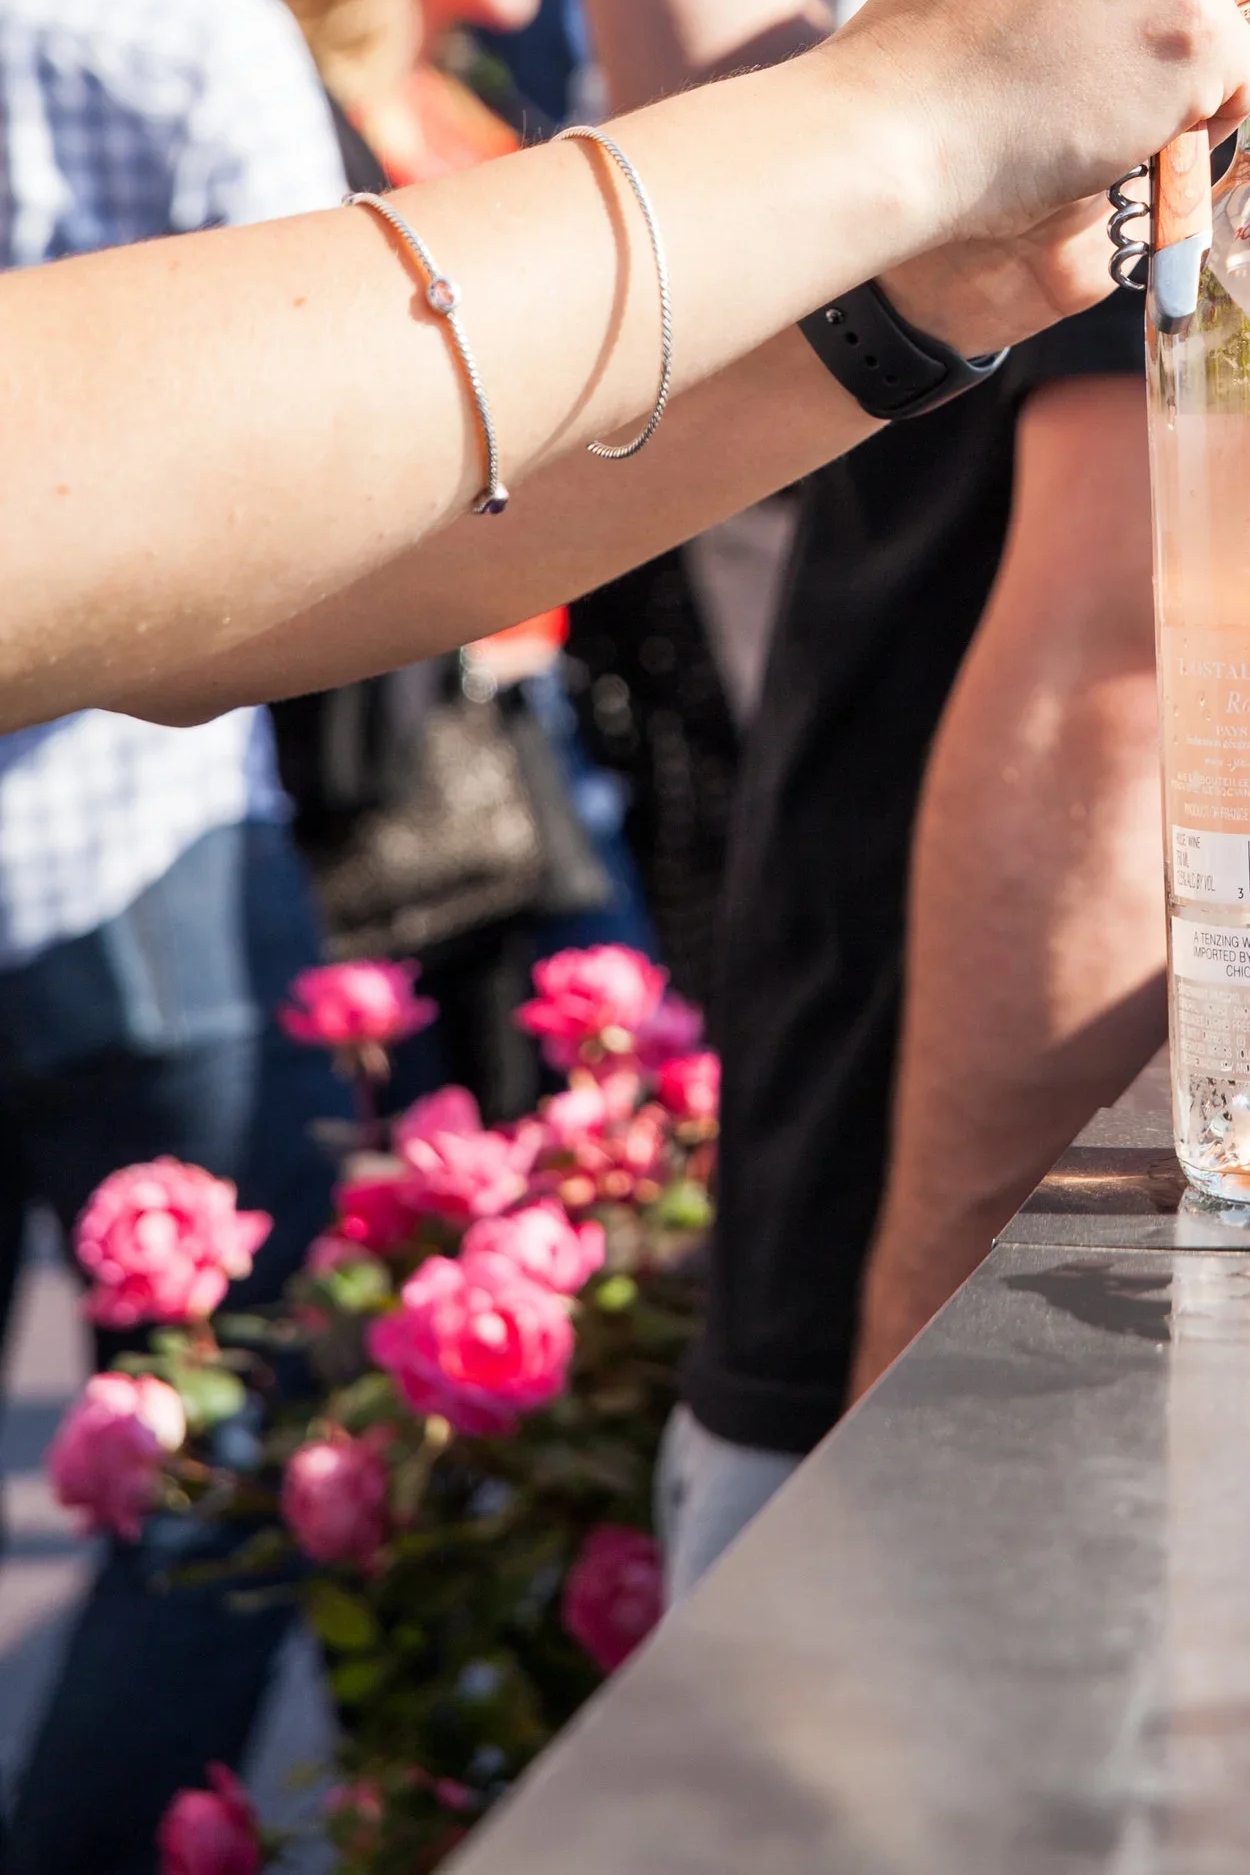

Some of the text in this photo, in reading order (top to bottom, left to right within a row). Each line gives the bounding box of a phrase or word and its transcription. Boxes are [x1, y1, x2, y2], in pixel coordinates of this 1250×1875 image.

[1216, 726, 1248, 737] PAYS
[1237, 888, 1245, 900] 3
[1193, 931, 1200, 942] A
[1201, 932, 1239, 949] TENZING
[1193, 947, 1237, 963] IMPORTED
